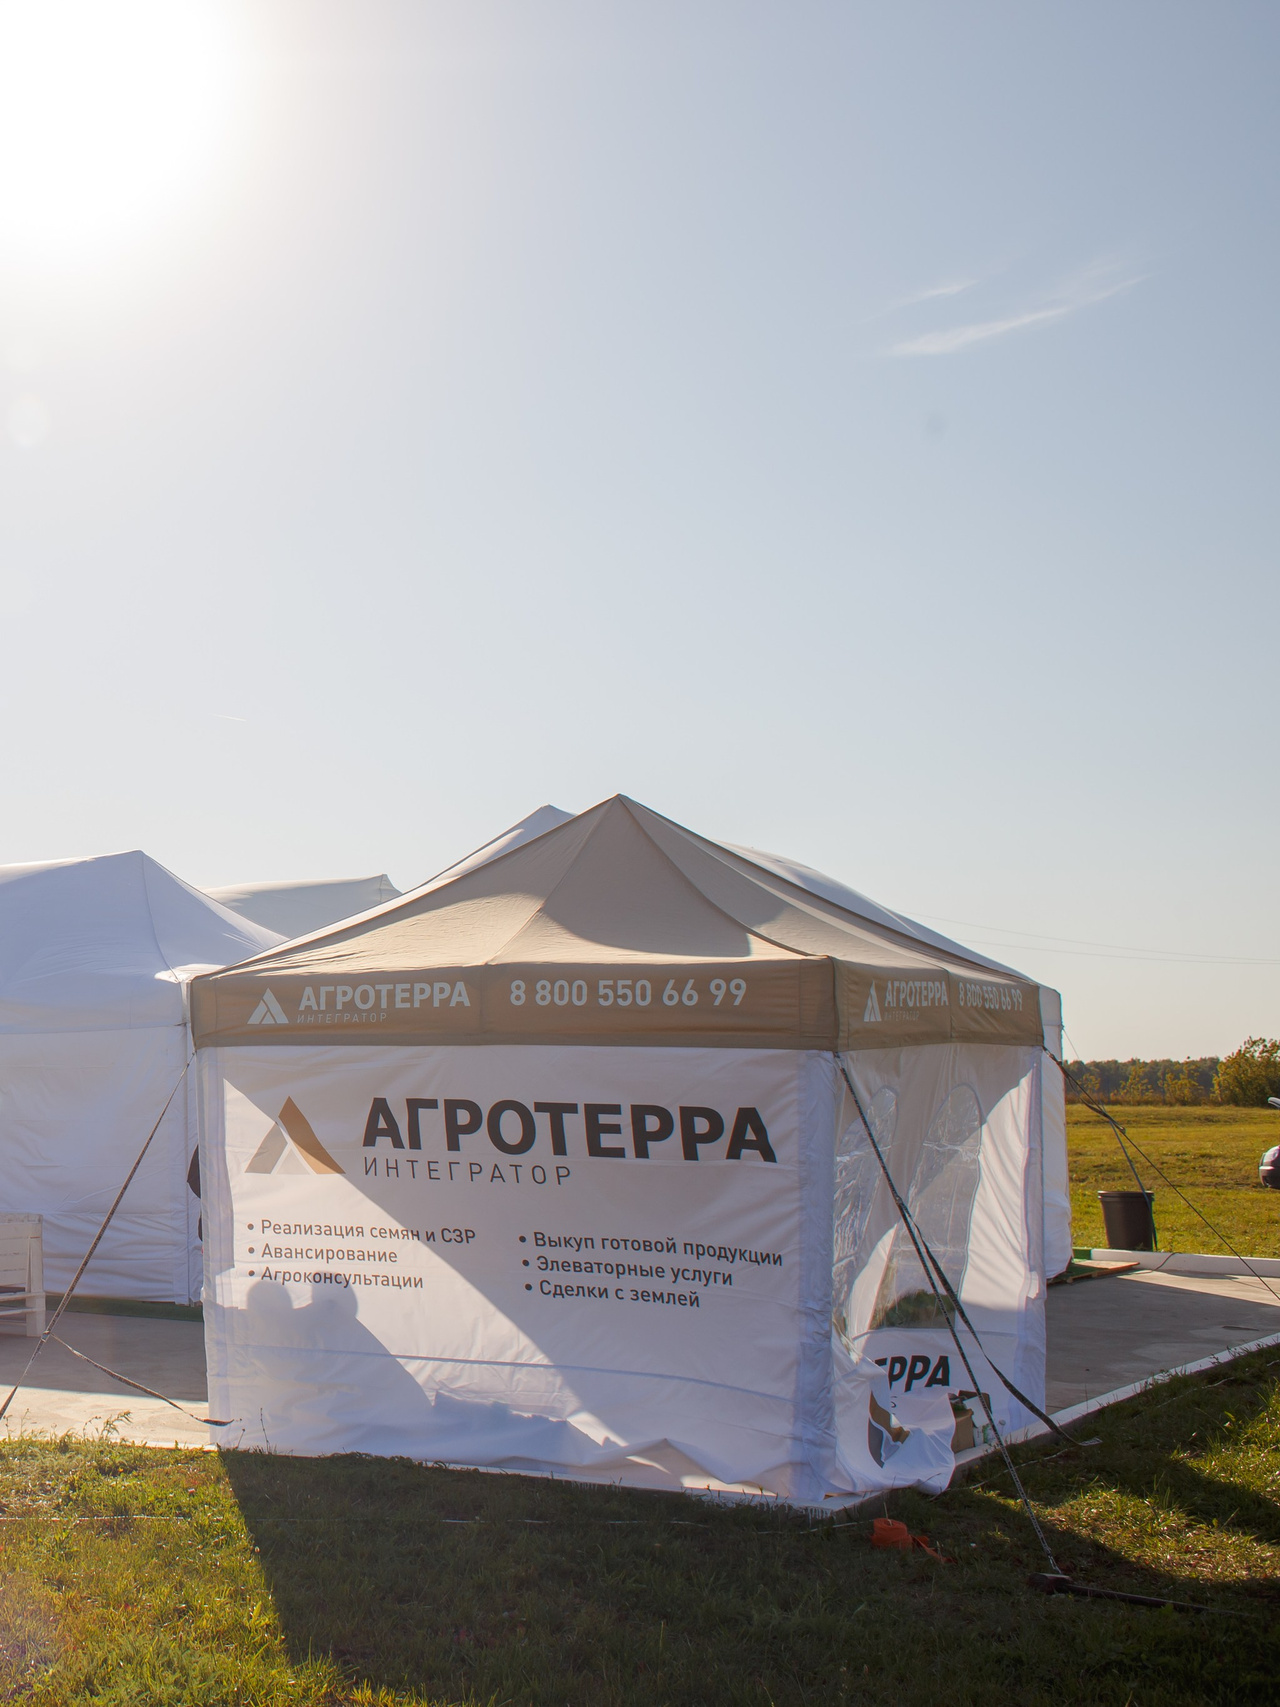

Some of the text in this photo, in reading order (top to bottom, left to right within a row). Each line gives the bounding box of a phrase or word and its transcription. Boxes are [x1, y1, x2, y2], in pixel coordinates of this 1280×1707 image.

[298, 981, 471, 1011] АГРОТЕРРА
[510, 978, 747, 1006] 8 800 550 66 99
[884, 980, 950, 1007] АГРОТЕРРА
[296, 1012, 388, 1024] ИНТЕГРАТОР
[362, 1096, 778, 1164] АГРОТЕРРА
[363, 1156, 571, 1186] ИНТЕГРАТОР
[261, 1219, 476, 1244] Реализация семян и СЗР
[261, 1242, 399, 1264] Авансирование
[533, 1231, 783, 1267] Выкуп готовой продукции
[261, 1266, 424, 1289] Агроконсультации
[536, 1255, 733, 1287] Элеваторные услуги
[539, 1279, 700, 1308] Сделки с землей
